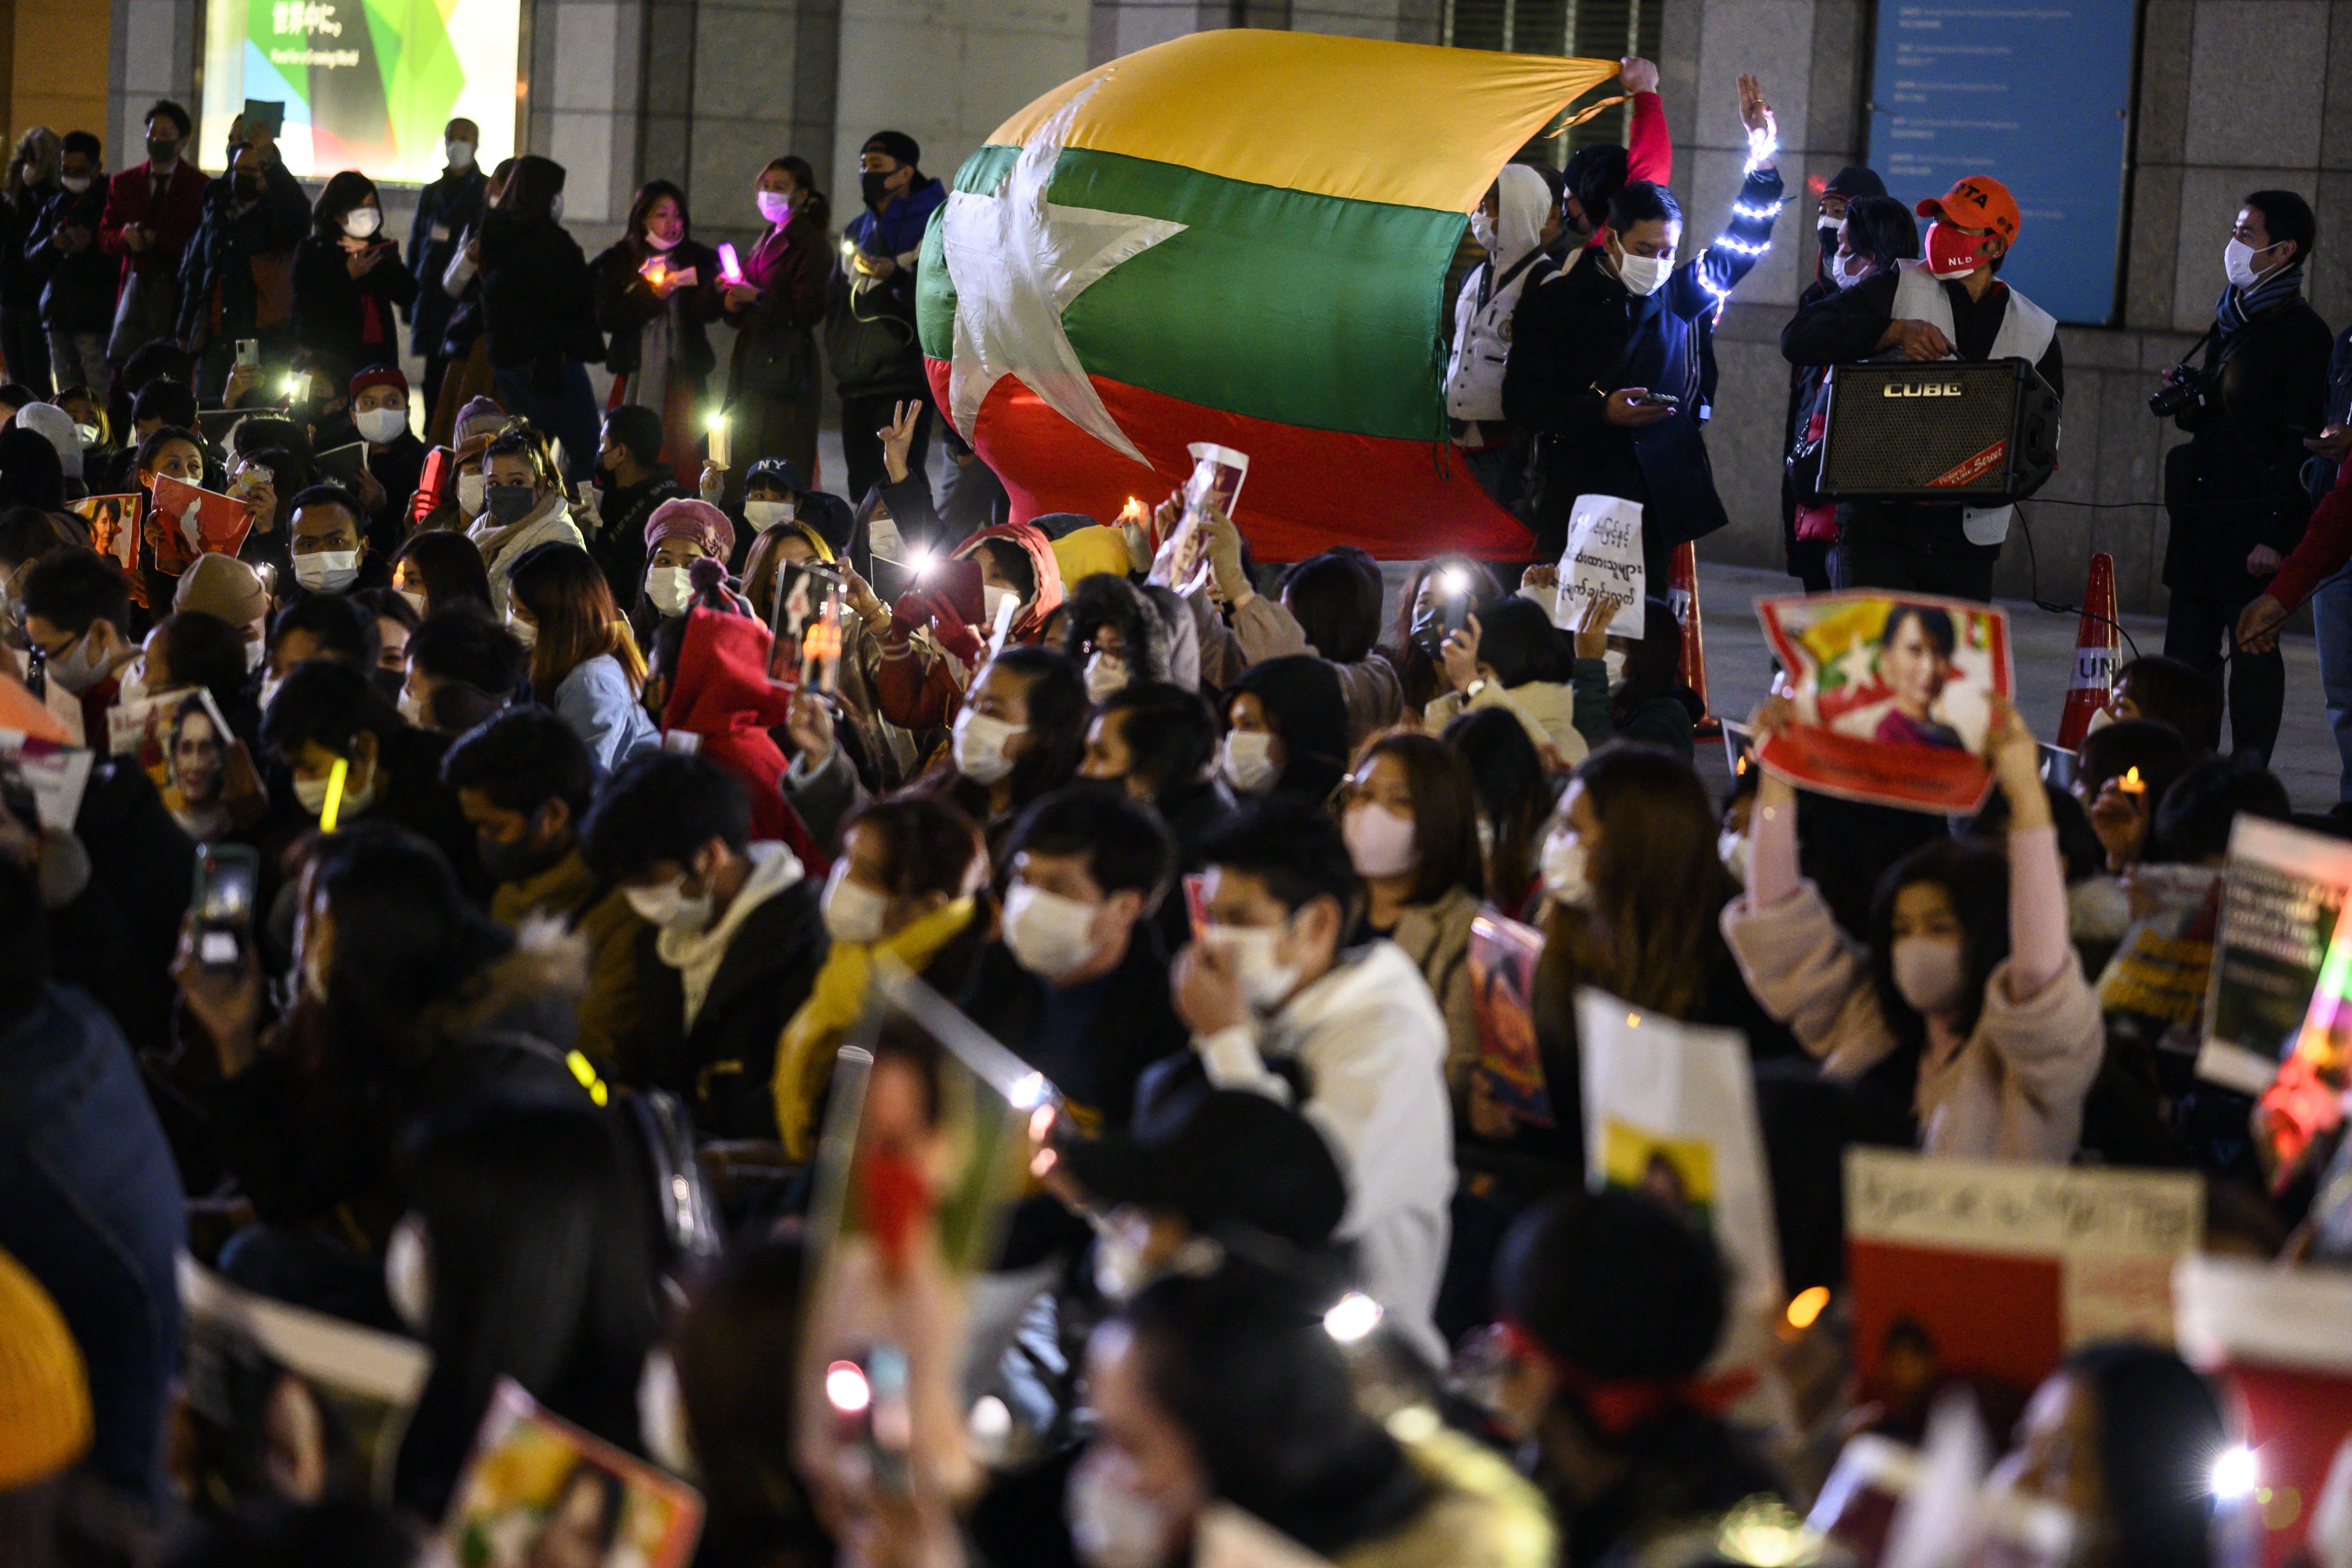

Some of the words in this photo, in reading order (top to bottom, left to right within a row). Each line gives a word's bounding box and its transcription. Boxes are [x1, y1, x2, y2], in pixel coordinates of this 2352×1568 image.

[1948, 257, 1972, 266] NLD
[1884, 383, 1962, 397] CUBE
[757, 459, 787, 470] NY
[2080, 657, 2120, 679] UN
